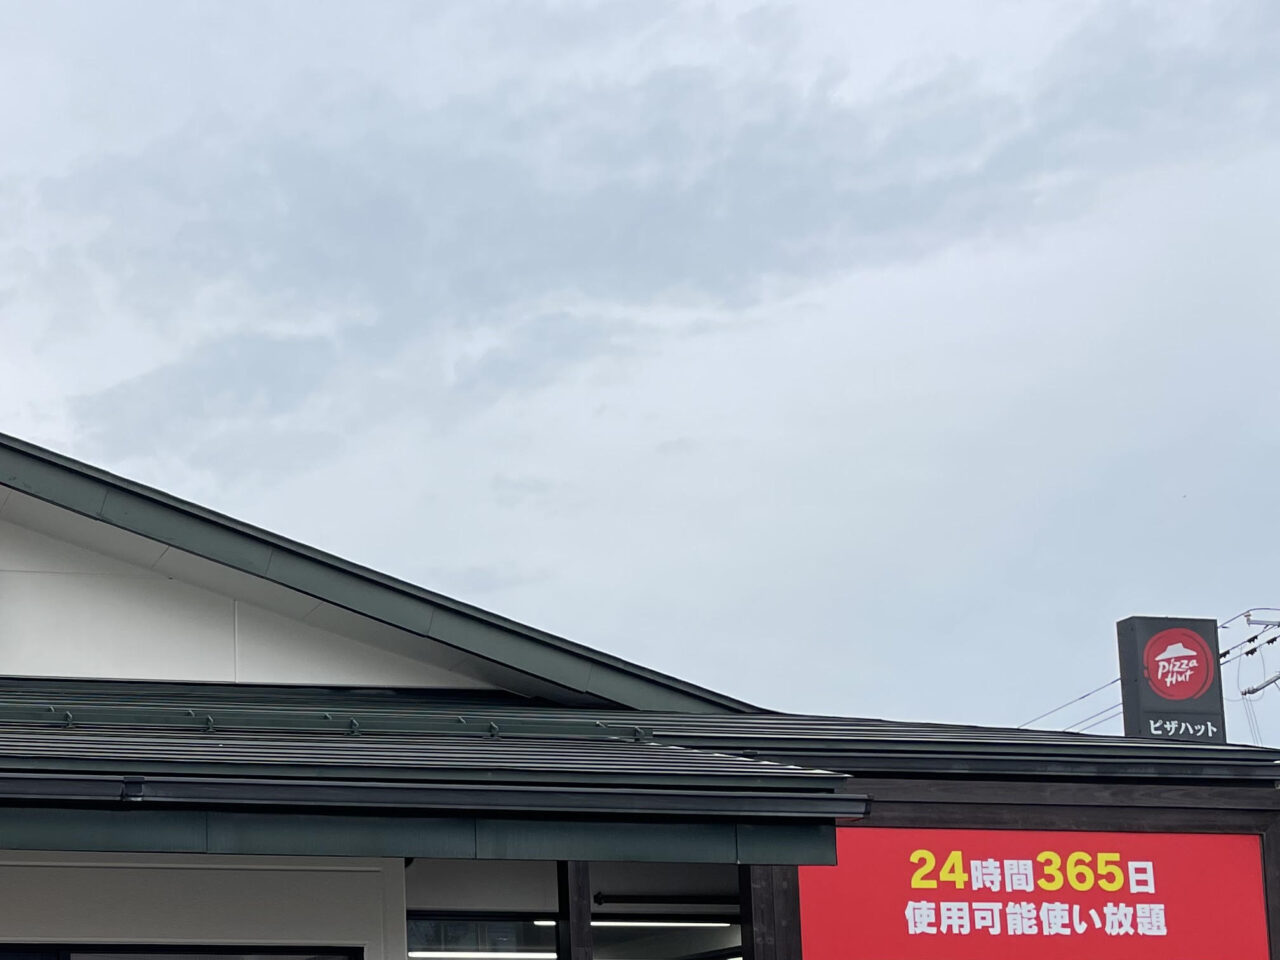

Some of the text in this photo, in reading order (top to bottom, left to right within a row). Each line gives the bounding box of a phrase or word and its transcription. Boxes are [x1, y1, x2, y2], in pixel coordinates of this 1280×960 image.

[1158, 658, 1198, 680] Pizza
[1165, 669, 1193, 687] Hut
[1149, 720, 1217, 737] ピザハット
[909, 848, 1155, 894] 24時間365日
[905, 902, 1167, 936] 使用可能使い放題
